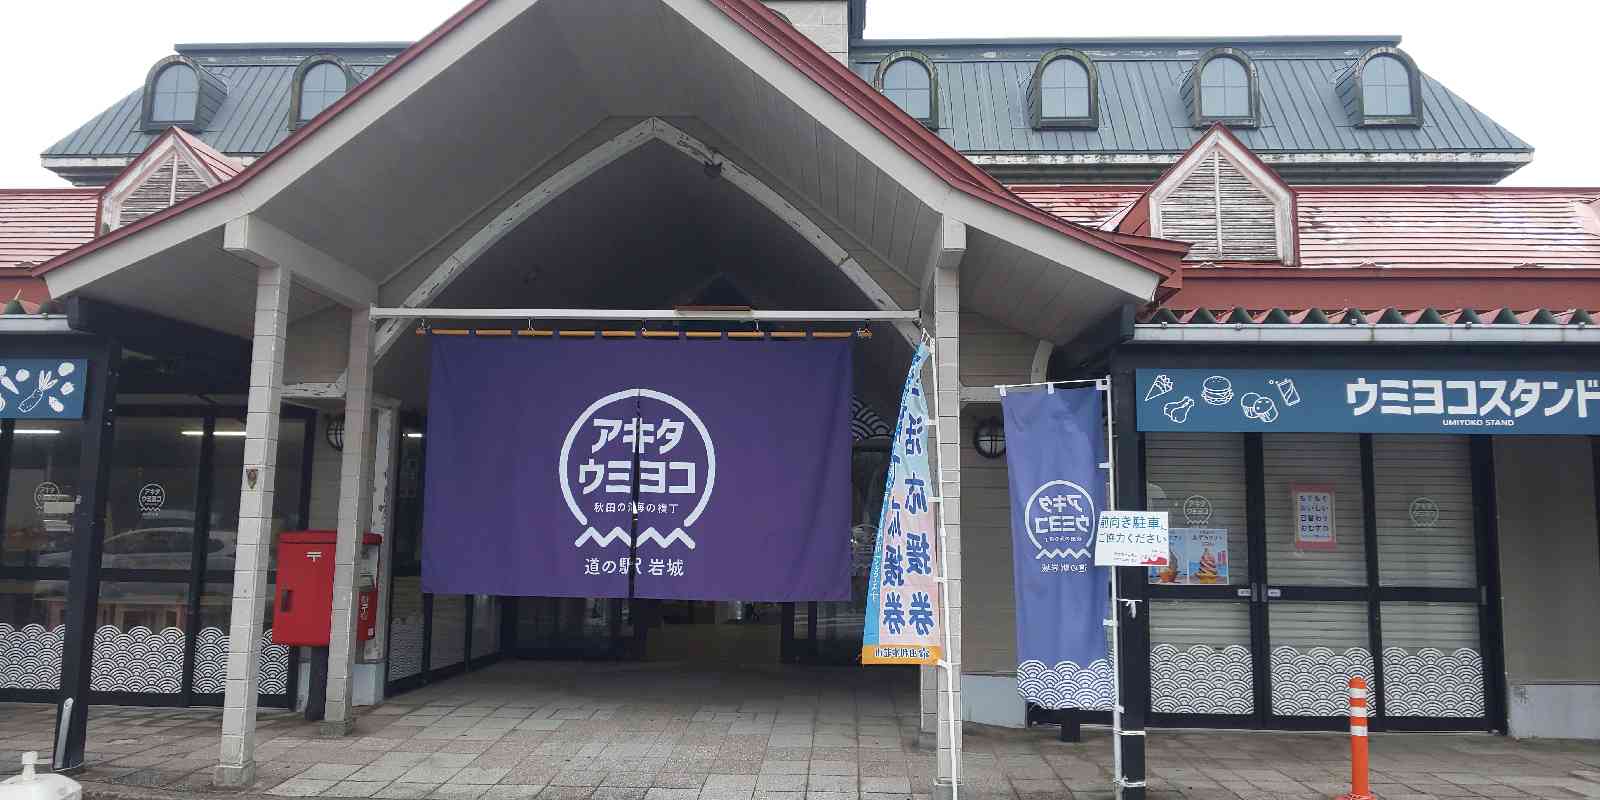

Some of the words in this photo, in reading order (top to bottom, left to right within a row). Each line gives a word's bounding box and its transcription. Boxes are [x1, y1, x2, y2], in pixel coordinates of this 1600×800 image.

[1346, 377, 1600, 417] ウミヨコスタンド
[591, 417, 685, 455] アキタ
[1442, 419, 1484, 427] UMIYOKO
[1485, 419, 1515, 427] STAND
[578, 458, 696, 495] ウミヨコ
[1098, 532, 1168, 545] ご協力ください
[648, 558, 685, 577] 岩城
